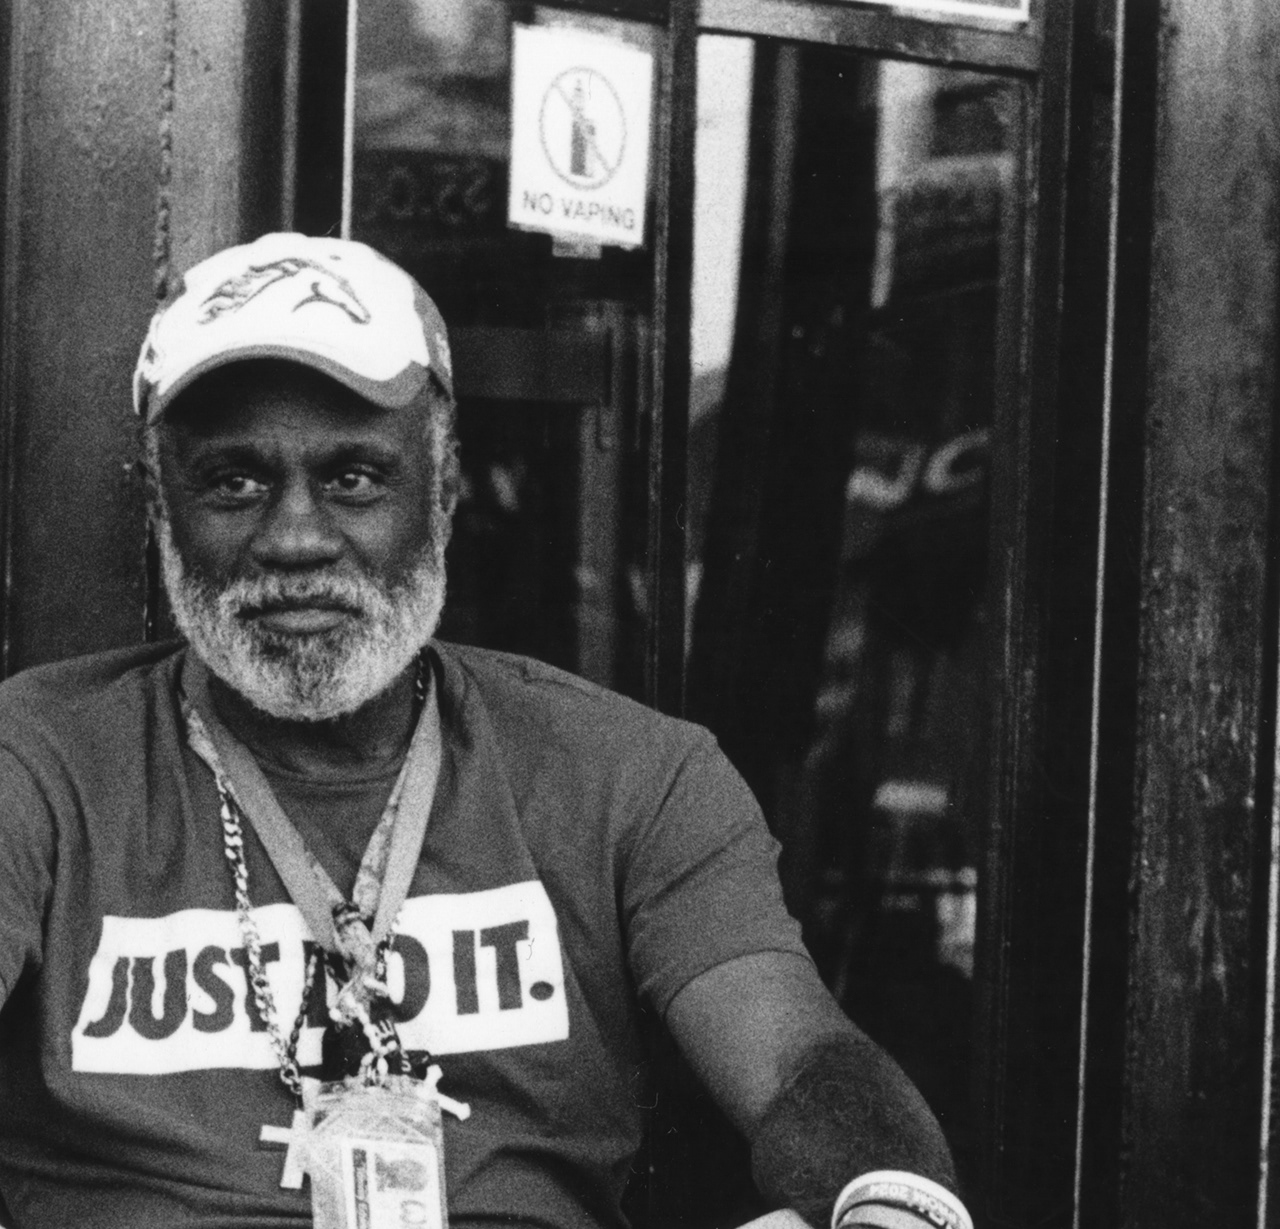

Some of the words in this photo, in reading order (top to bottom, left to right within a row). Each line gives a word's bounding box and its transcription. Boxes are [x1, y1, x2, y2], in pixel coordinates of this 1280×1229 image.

[522, 190, 553, 215] NO
[560, 198, 636, 230] VAPING
[82, 939, 281, 1040] JUST
[451, 920, 555, 1016] IT.
